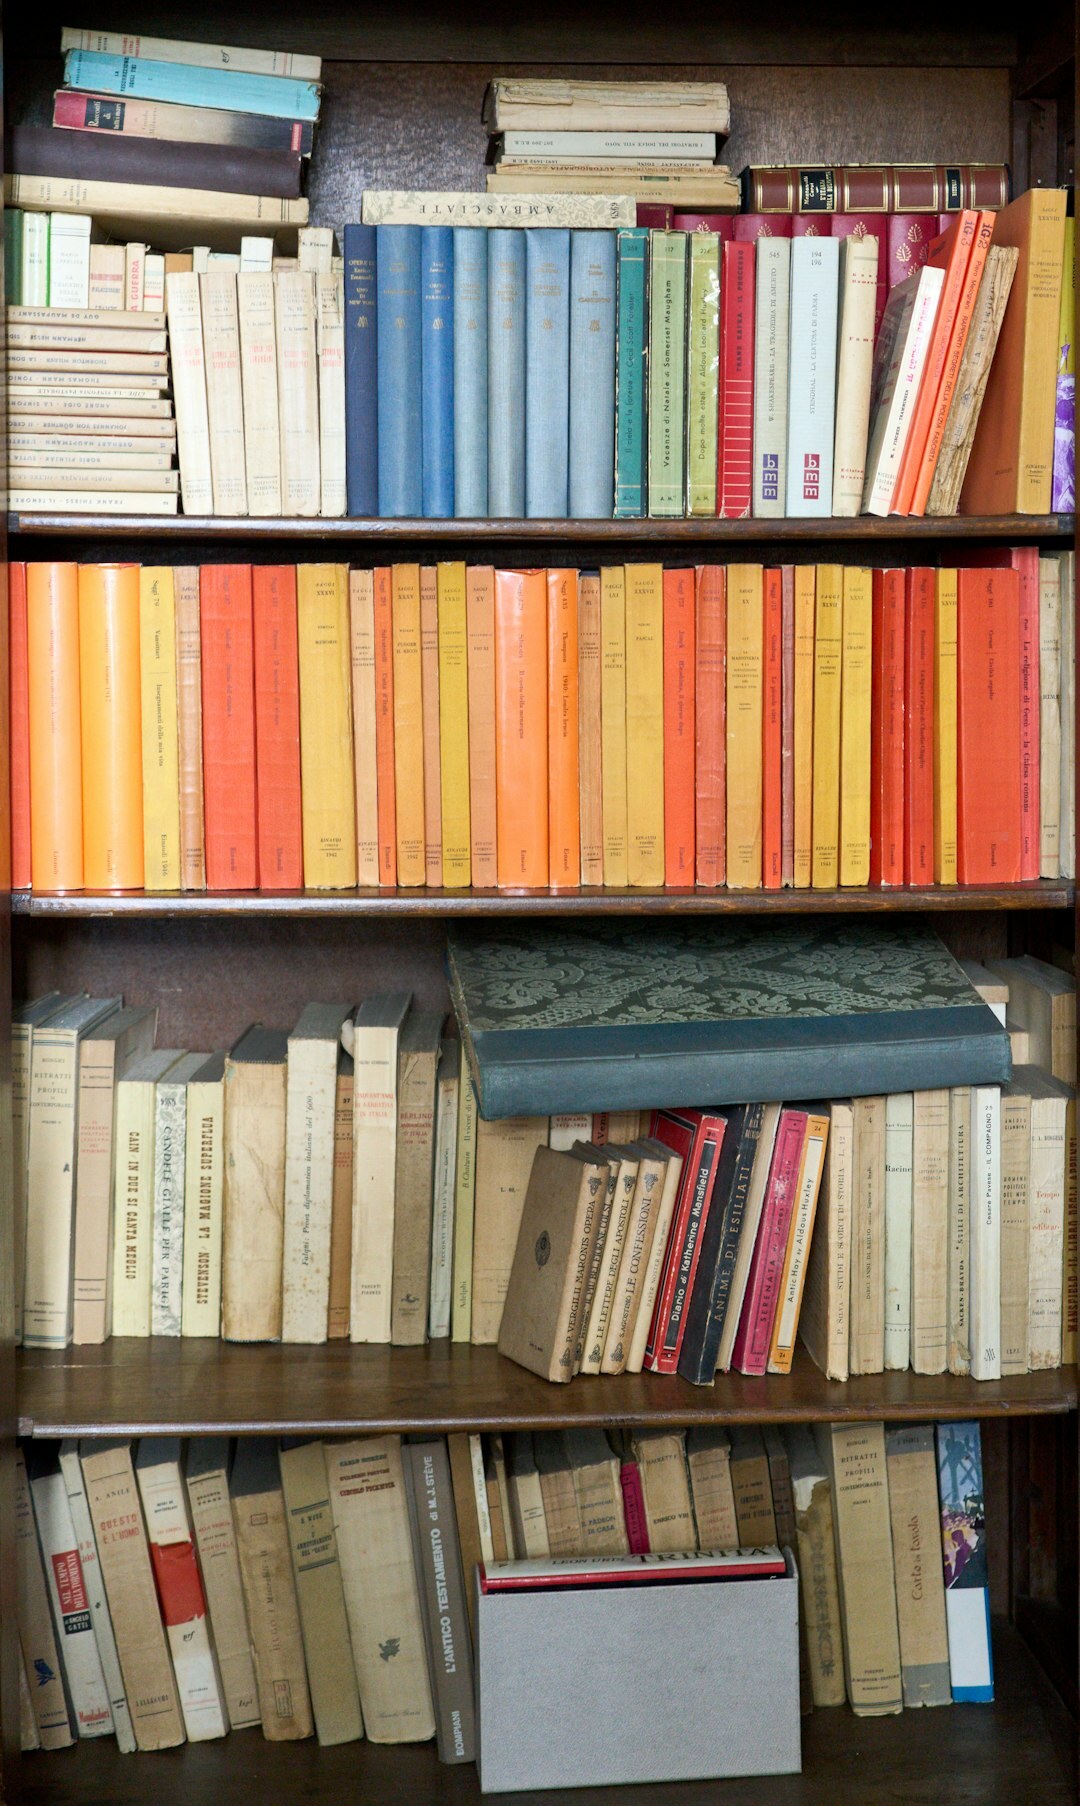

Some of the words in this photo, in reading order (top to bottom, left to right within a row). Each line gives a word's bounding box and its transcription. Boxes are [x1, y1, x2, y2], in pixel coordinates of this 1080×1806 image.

[88, 101, 101, 127] Racconti
[418, 204, 554, 215] AMBASCIATE
[972, 260, 982, 277] Piero
[664, 280, 672, 323] Maugham
[770, 298, 776, 306] DI
[964, 278, 978, 310] Melograni
[812, 318, 818, 326] DI
[957, 315, 968, 348] RAPPORTI
[626, 324, 634, 345] Scott
[626, 346, 634, 368] Cecil
[770, 347, 776, 358] LA
[811, 362, 816, 372] LA
[948, 349, 960, 380] SEGRETI
[944, 380, 952, 398] DELLA
[698, 414, 706, 435] molte
[936, 400, 947, 428] POLIZIA
[698, 440, 706, 460] Dopo
[928, 430, 940, 463] FASCISTA
[154, 630, 162, 660] Vansittart
[1024, 641, 1030, 651] La
[1022, 654, 1030, 692] religione
[1024, 694, 1030, 705] di
[1024, 740, 1030, 749] la
[128, 1132, 140, 1152] CAIN
[200, 1116, 214, 1170] SUPERFLUA
[304, 1132, 312, 1162] italiana
[162, 1126, 172, 1183] CANDELE
[128, 1161, 139, 1172] IN
[885, 1164, 912, 1173] Racine
[128, 1176, 138, 1193] DUE
[304, 1166, 312, 1210] diplomatica
[802, 1178, 814, 1210] Huxley
[127, 1198, 138, 1206] SI
[198, 1176, 212, 1220] MAGIONE
[958, 1203, 964, 1214] DI
[162, 1188, 172, 1232] GIALLE
[126, 1211, 138, 1240] CANTA
[198, 1226, 210, 1239] LA
[302, 1214, 310, 1234] Prosa
[796, 1212, 808, 1244] Aldous
[630, 1198, 652, 1274] CONFESSIONI
[671, 1288, 685, 1322] Diario
[681, 1222, 698, 1272] Katherine
[694, 1168, 710, 1218] Mansfield
[714, 1270, 732, 1322] ANIME
[724, 1244, 736, 1259] DI
[730, 1167, 750, 1233] ESILIATI
[162, 1238, 170, 1260] PER
[126, 1246, 137, 1280] MEGLIO
[568, 1286, 582, 1332] VERGILII
[576, 1237, 590, 1283] MARONIS
[584, 1200, 596, 1234] OPERA
[596, 1326, 604, 1339] LE
[600, 1284, 614, 1322] LETTERE
[608, 1248, 620, 1281] DEGLI
[615, 1199, 630, 1244] APOSTOLI
[791, 1259, 802, 1276] Hay
[196, 1252, 210, 1304] STEVENSON
[626, 1277, 636, 1294] LE
[760, 1260, 776, 1322] SERENATA
[788, 1278, 796, 1302] Antic
[846, 1439, 869, 1447] BONGHI
[840, 1452, 878, 1464] RITRATTI
[424, 1456, 432, 1486] STÈVE
[845, 1468, 875, 1477] PROFILI
[106, 1488, 130, 1499] ANILE
[340, 1486, 364, 1498] CIRCOLO
[840, 1482, 883, 1492] CONTEMPORANEI
[428, 1496, 437, 1510] M.
[100, 1513, 138, 1531] QUESTO
[430, 1511, 438, 1521] di
[588, 1515, 616, 1526] PADRON
[653, 1514, 676, 1524] ENRICO
[112, 1527, 140, 1541] L'UOMO
[596, 1524, 616, 1534] CASA
[910, 1515, 921, 1552] tavola
[56, 1562, 70, 1588] TEMPO
[66, 1552, 82, 1587] TORMENTA
[430, 1528, 449, 1613] TESTAMENTO
[62, 1590, 72, 1605] NEL
[71, 1586, 84, 1608] DELLA
[67, 1622, 88, 1632] GATTI
[70, 1614, 90, 1625] ANGELO
[440, 1616, 457, 1674] L'ANTICO
[78, 1709, 110, 1724] Mondadori
[451, 1710, 464, 1756] BOMPIANI
